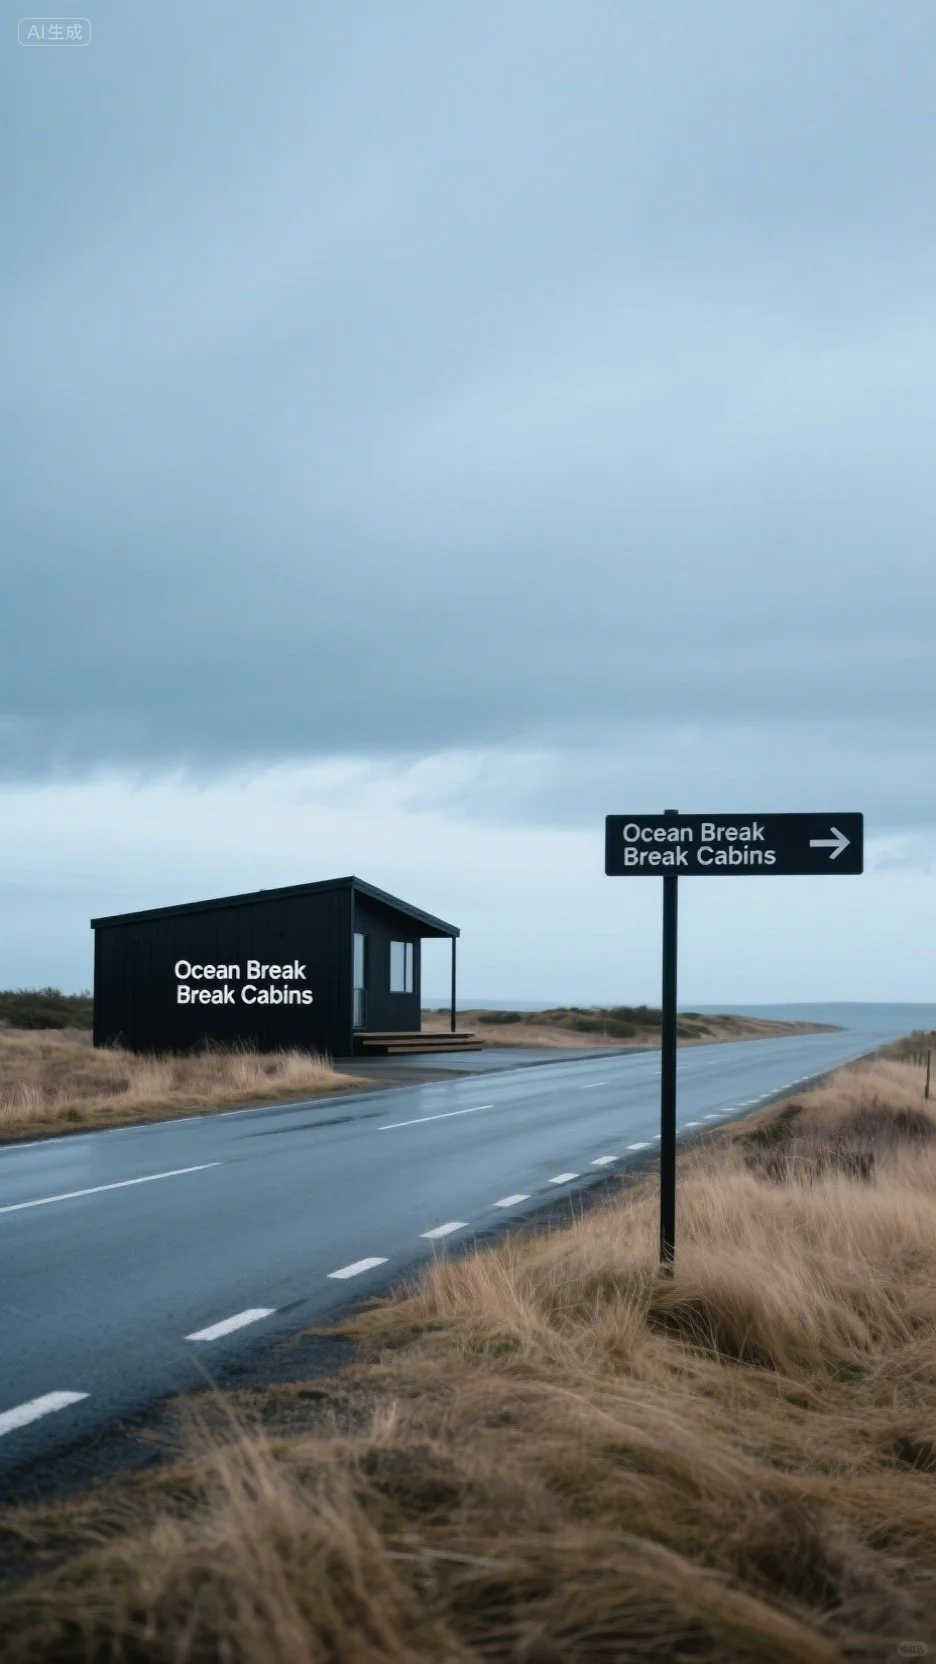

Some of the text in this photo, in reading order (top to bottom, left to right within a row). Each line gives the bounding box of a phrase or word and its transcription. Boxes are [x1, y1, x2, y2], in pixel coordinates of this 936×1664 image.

[622, 821, 765, 843] Ocean Break
[623, 844, 777, 866] Break Cabins
[174, 959, 307, 980] Ocean Break
[176, 984, 314, 1005] Break Cabins
